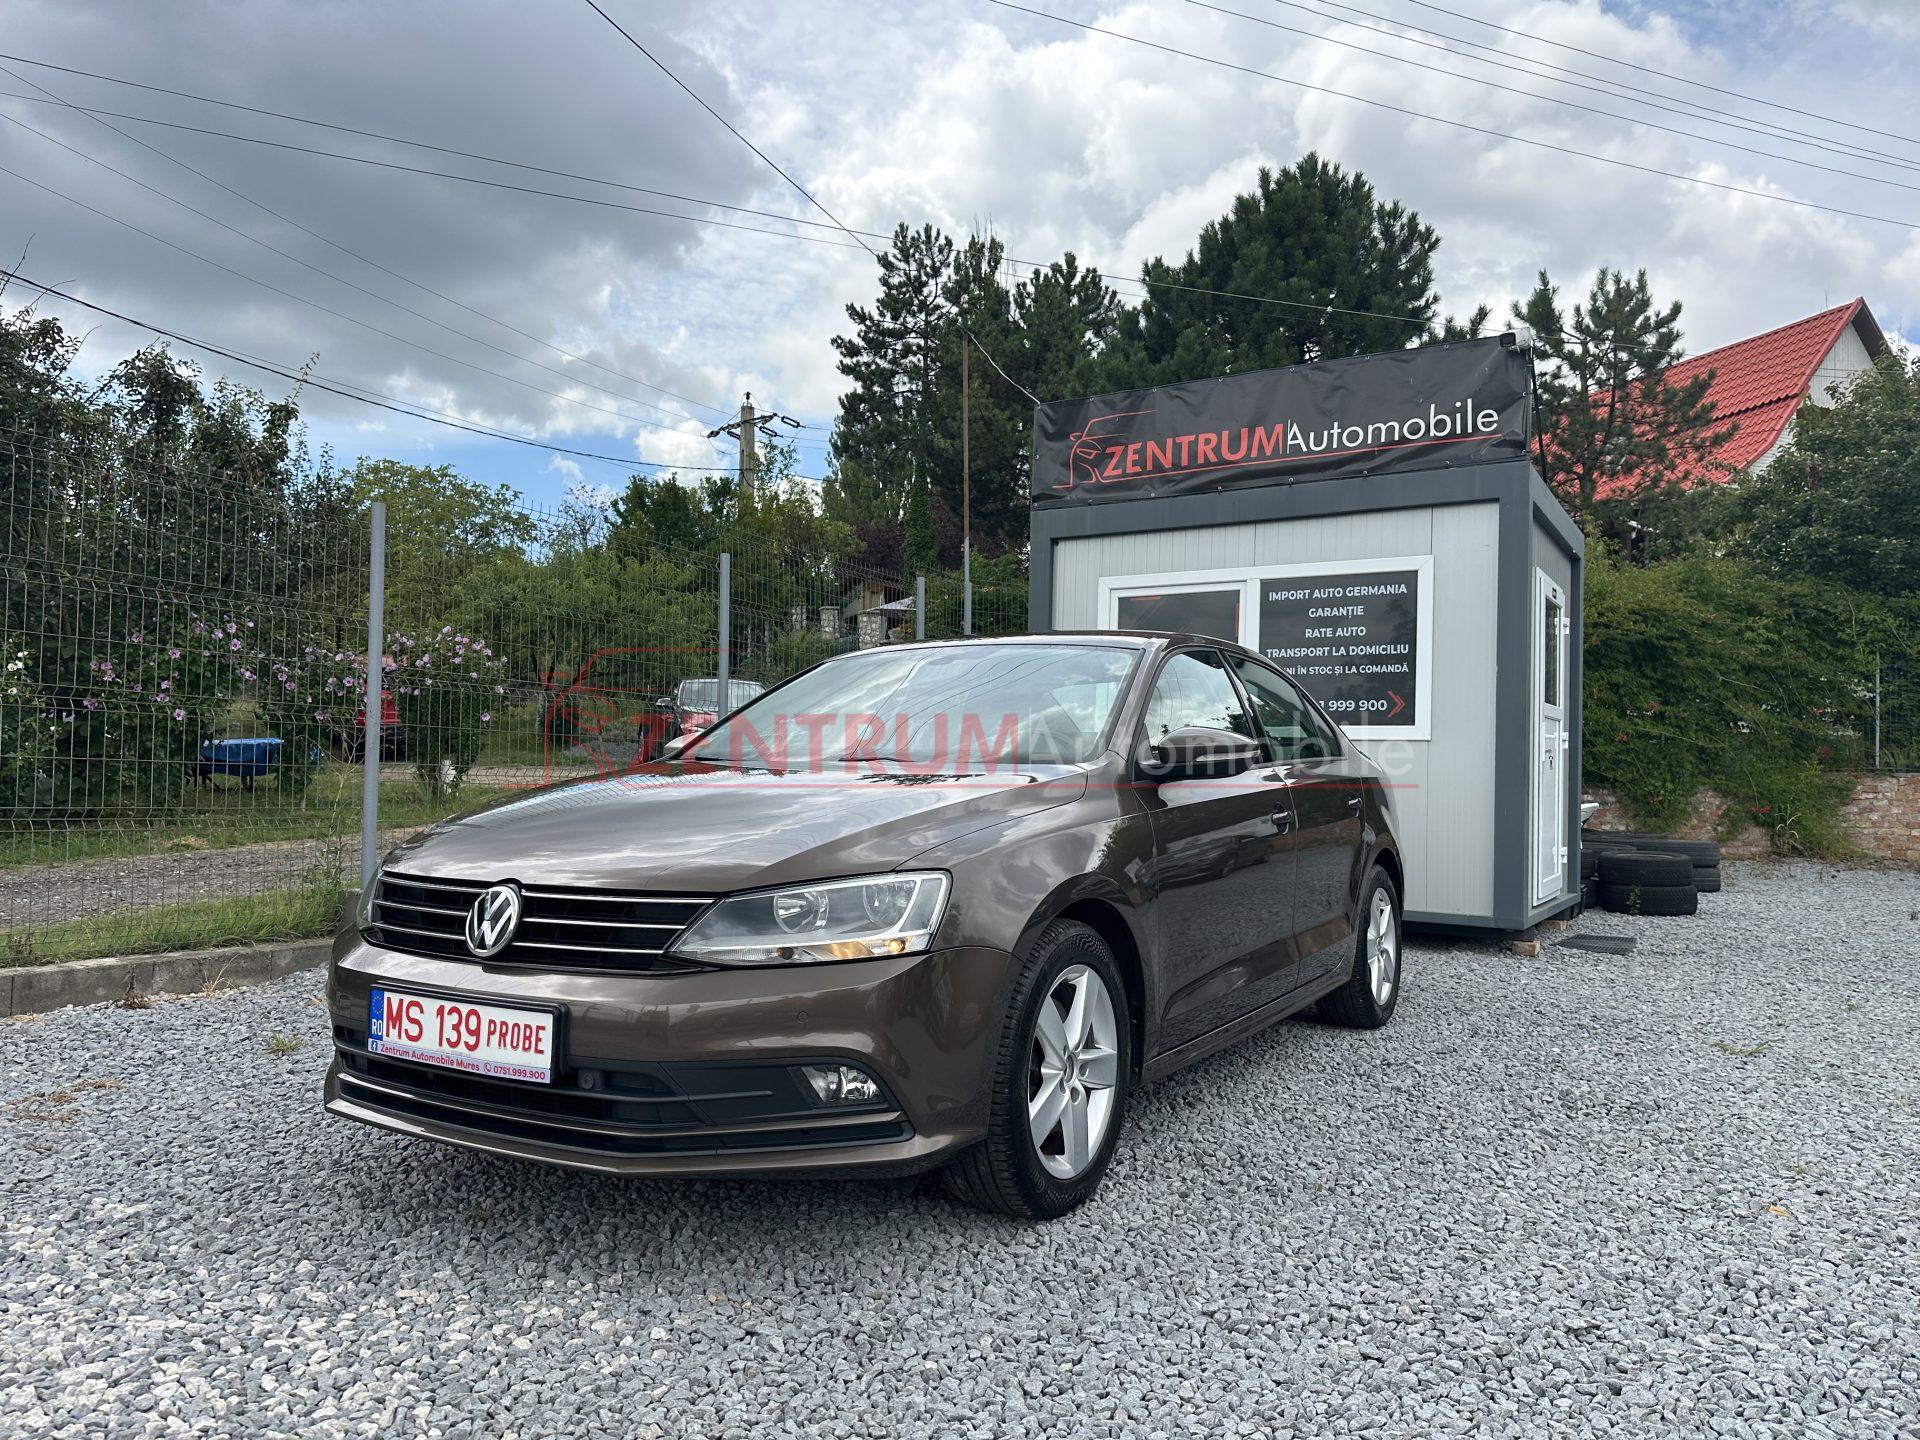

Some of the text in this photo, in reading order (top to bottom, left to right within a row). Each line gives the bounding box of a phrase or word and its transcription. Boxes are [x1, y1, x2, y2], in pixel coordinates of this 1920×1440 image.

[1104, 398, 1499, 477] ZENTRUM Automobile
[1269, 584, 1408, 601] IMPORT AUTO GERMANIA
[1308, 606, 1364, 618] GARANȚIE
[1305, 626, 1367, 638] RATE AUTO
[1266, 644, 1409, 658] TRANSPORT LA DOMICILIU
[1298, 666, 1307, 675] ÎN
[1309, 666, 1333, 675] STOC
[1345, 666, 1357, 674] LA
[1359, 662, 1409, 673] COMANDĂ
[1328, 700, 1355, 711] 999
[1358, 700, 1388, 711] 900
[371, 1018, 383, 1036] RO
[385, 996, 546, 1055] MS 139 PROBE
[380, 1043, 410, 1057] Zentrum
[411, 1050, 455, 1066] Automobile
[456, 1058, 480, 1071] Mures
[493, 1065, 546, 1080] 0751.999.900
